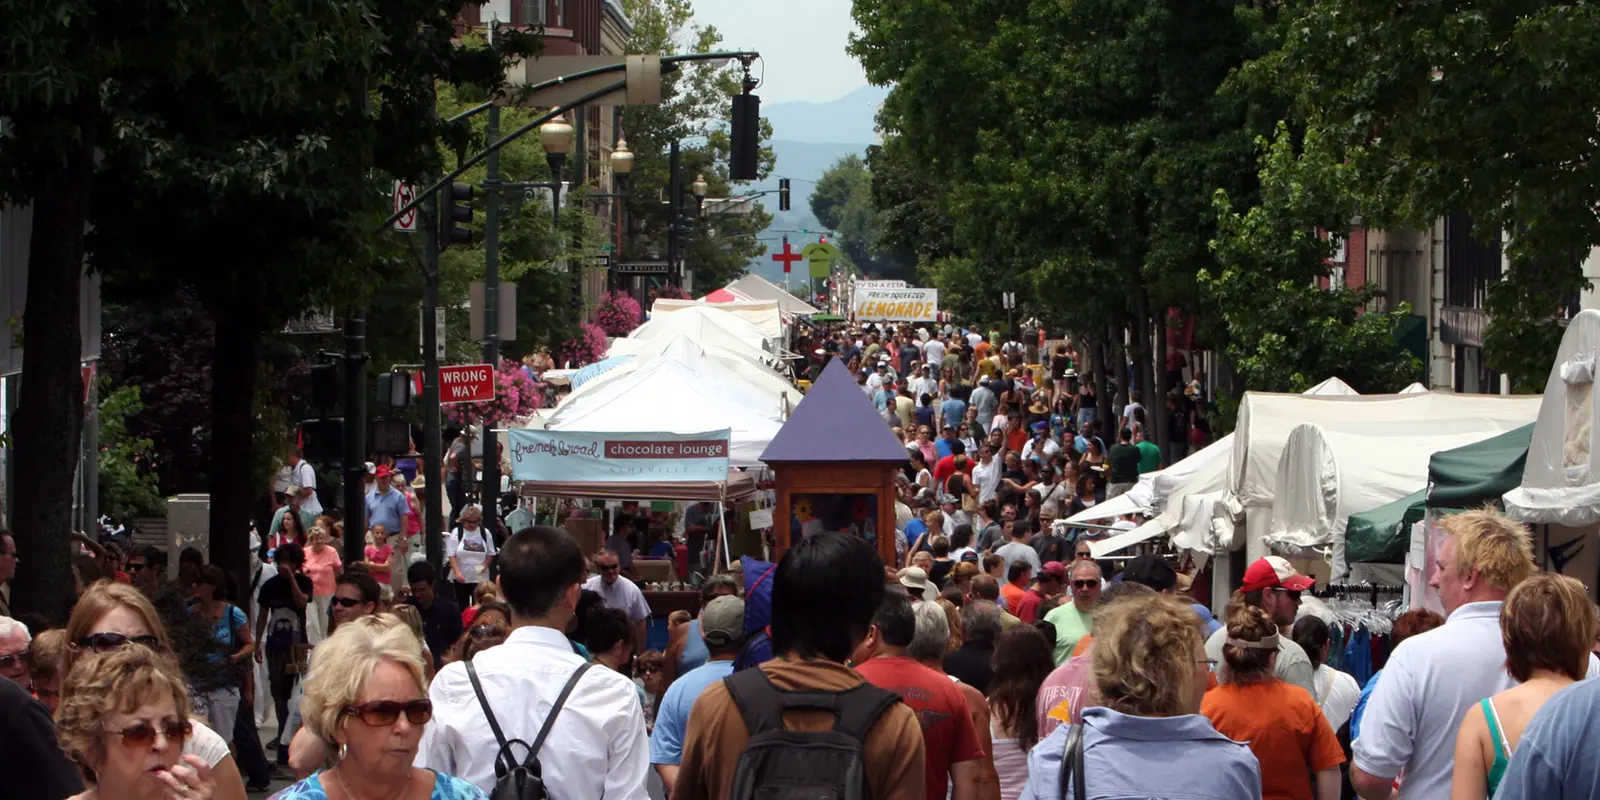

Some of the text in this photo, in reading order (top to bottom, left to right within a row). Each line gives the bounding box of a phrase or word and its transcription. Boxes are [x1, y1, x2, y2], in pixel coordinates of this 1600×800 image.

[868, 291, 926, 300] FRESH SQUEEZED
[858, 301, 934, 318] LEMONADE
[442, 370, 487, 384] WRONG
[451, 385, 479, 397] WAY
[511, 439, 723, 463] french broad chocolate lounge
[1060, 685, 1083, 714] SATY
